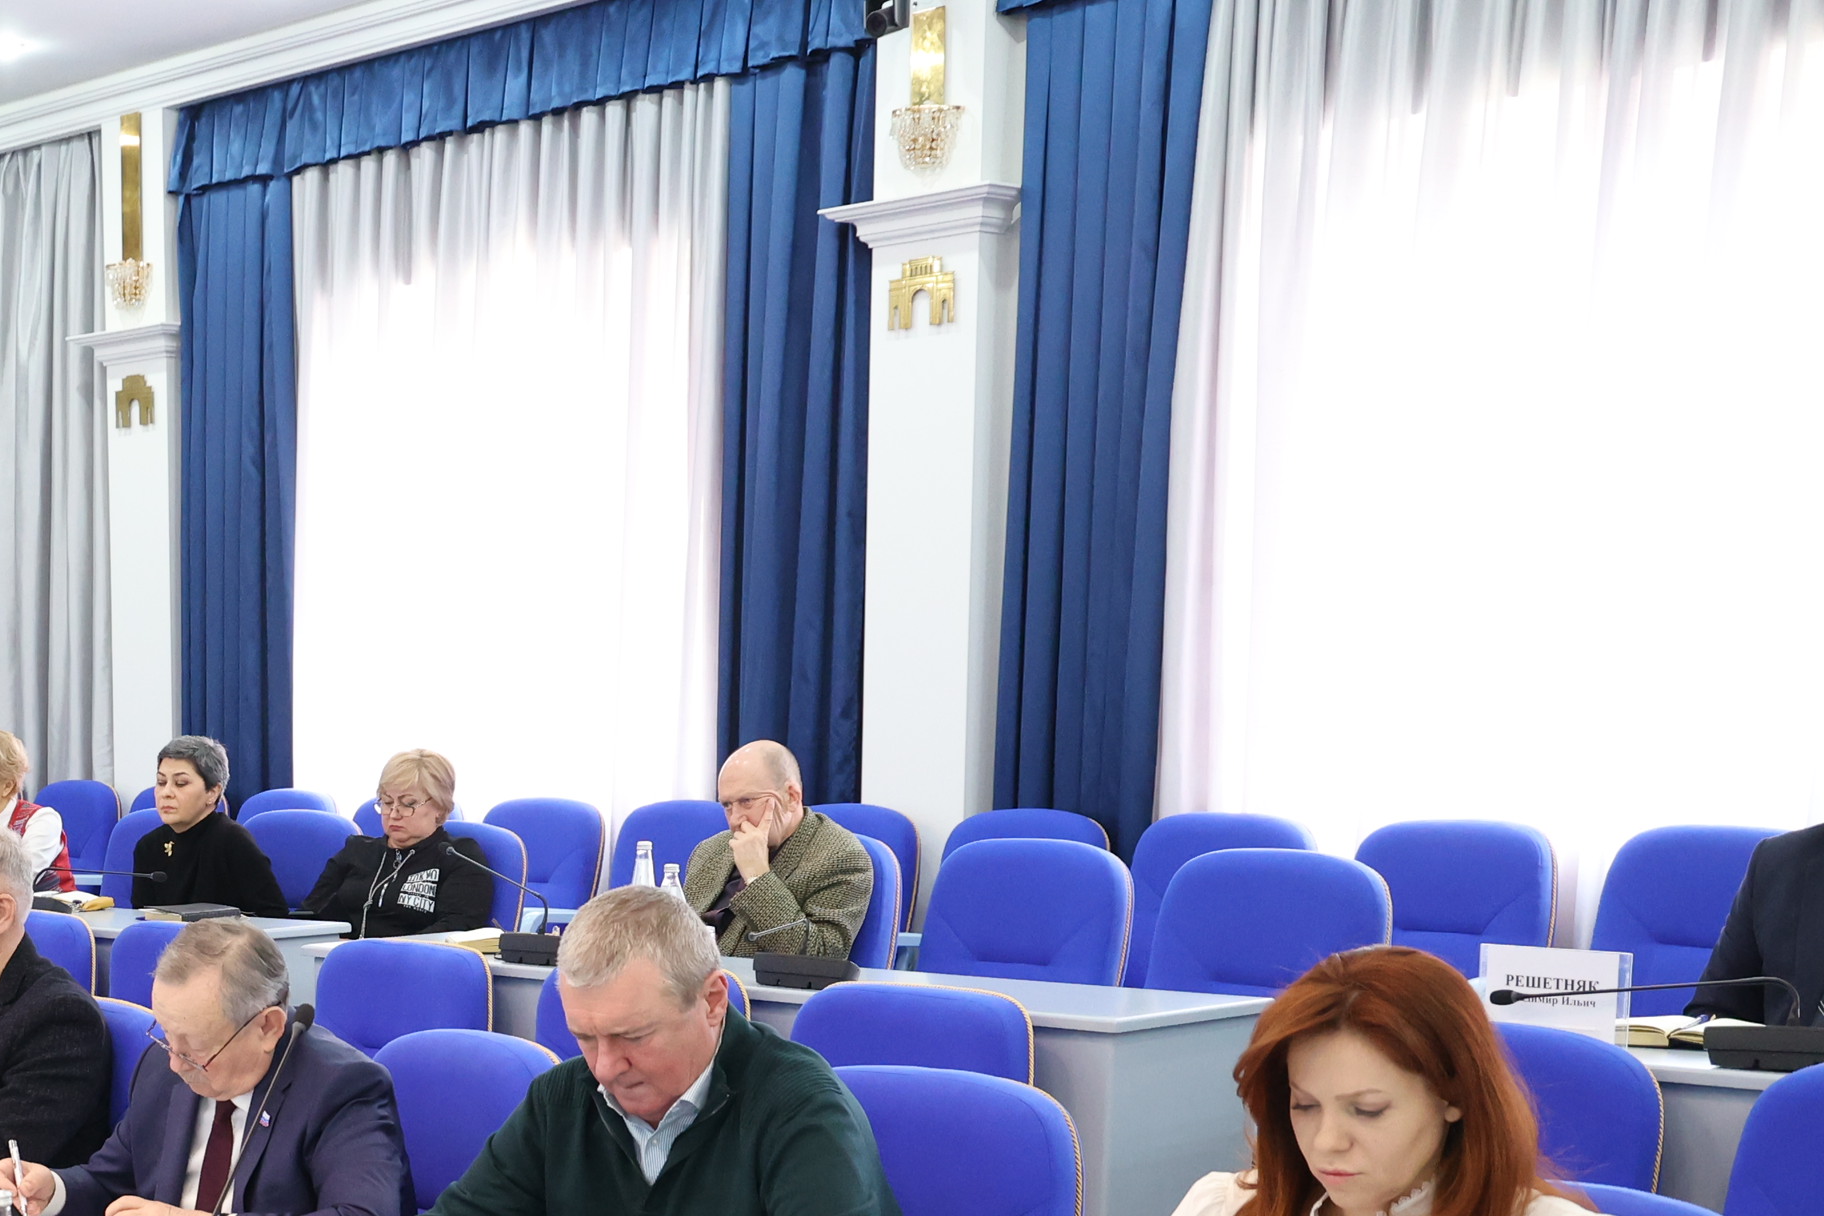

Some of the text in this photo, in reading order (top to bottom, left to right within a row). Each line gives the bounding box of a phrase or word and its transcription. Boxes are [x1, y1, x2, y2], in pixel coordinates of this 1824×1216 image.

[402, 883, 436, 896] LONDON
[1505, 974, 1599, 992] РЕШЕТНЯК
[1562, 996, 1596, 1008] Ильич
